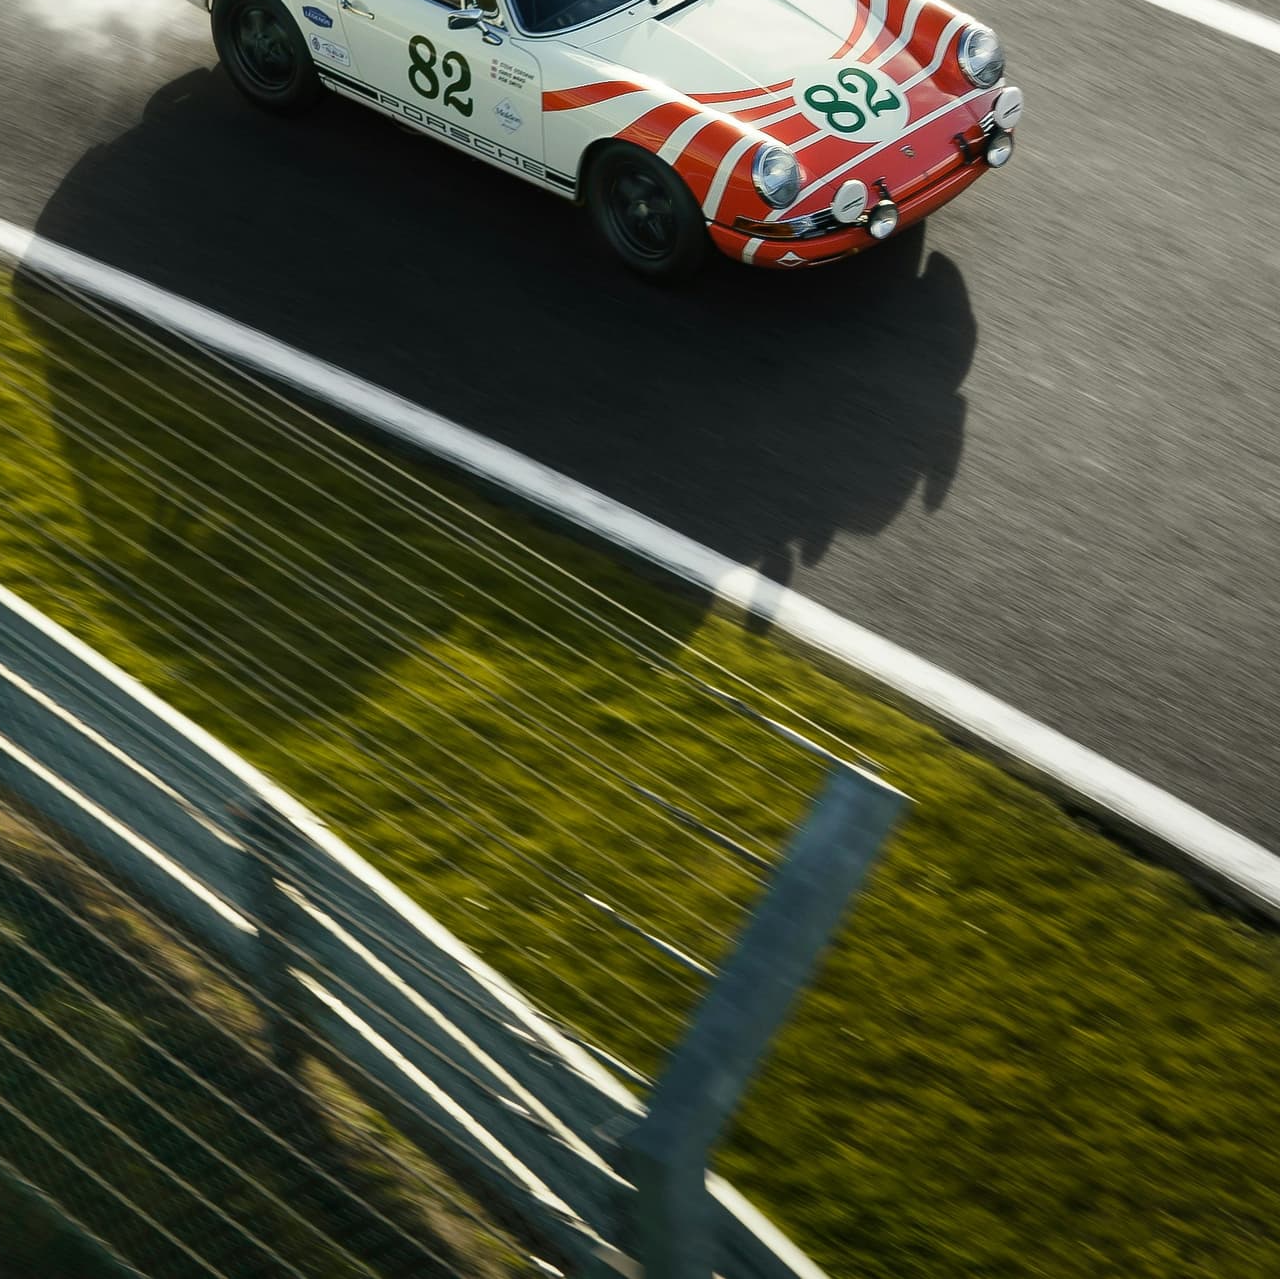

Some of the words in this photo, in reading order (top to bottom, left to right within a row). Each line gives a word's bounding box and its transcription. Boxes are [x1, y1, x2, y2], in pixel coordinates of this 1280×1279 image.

[408, 34, 474, 118] 82
[803, 67, 901, 133] 82
[379, 94, 544, 177] PORSCHE
